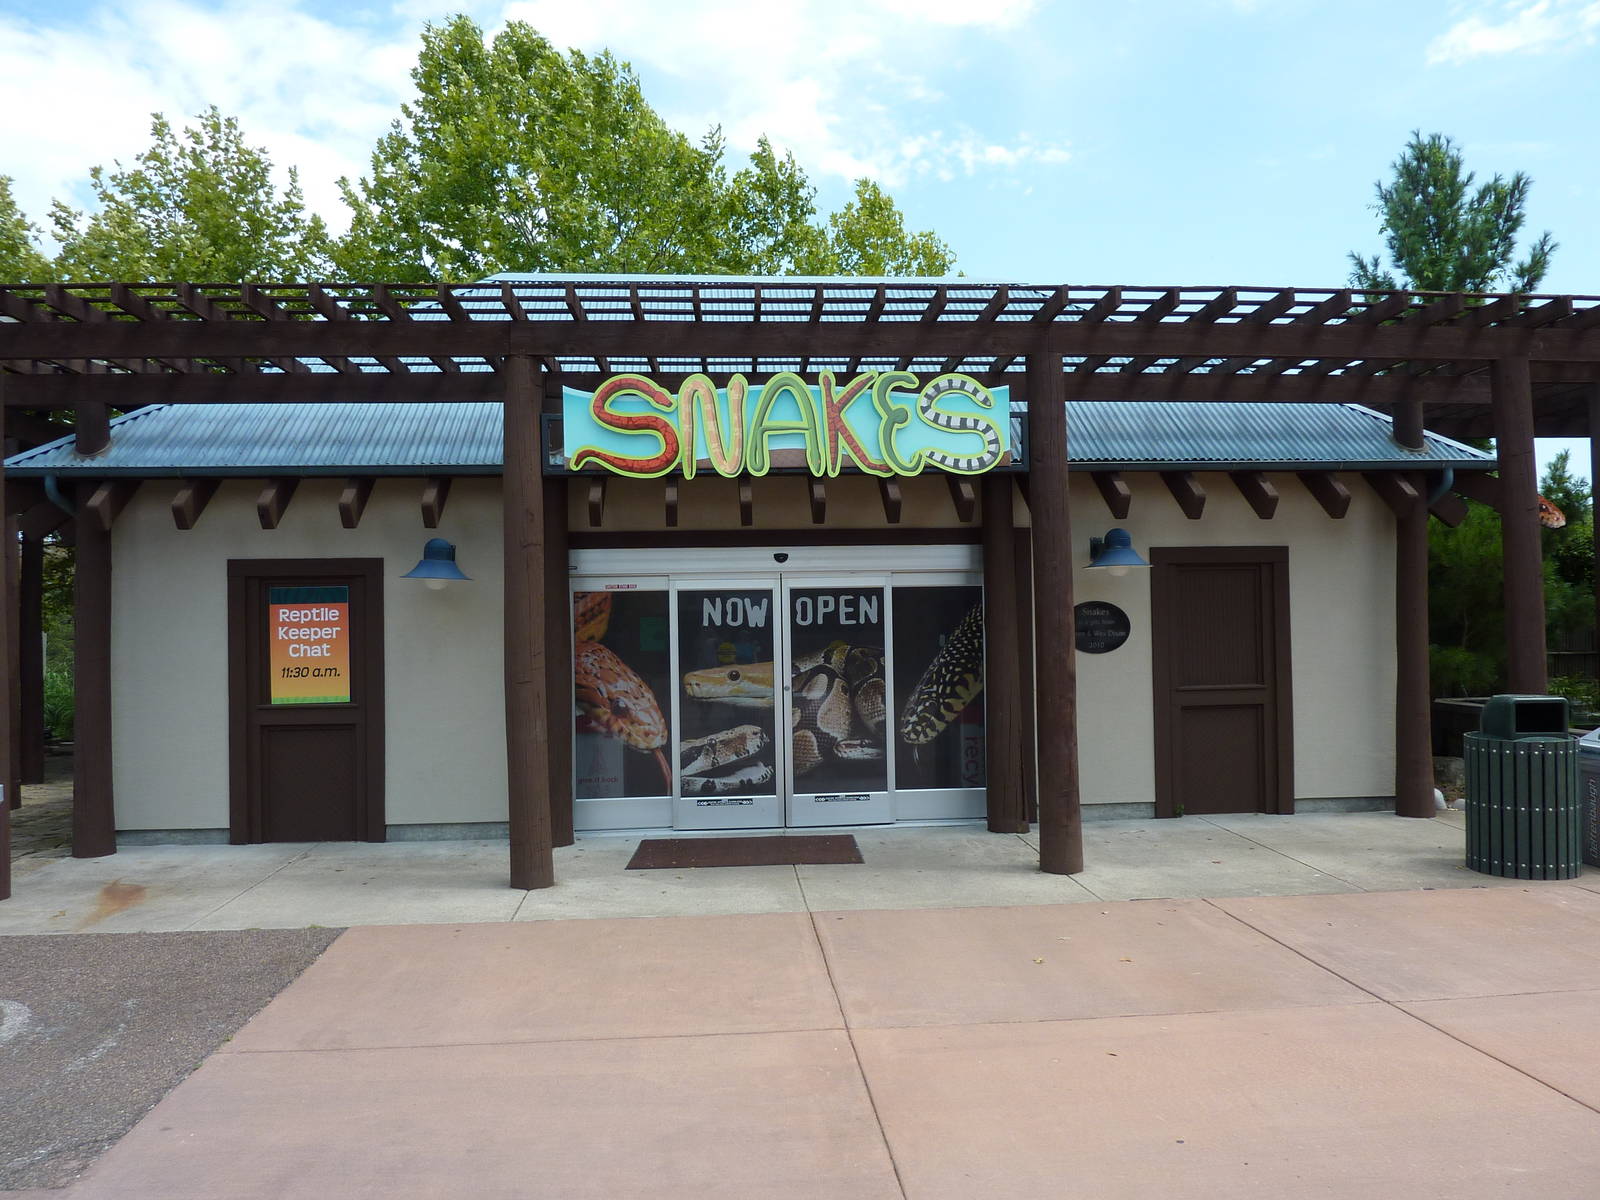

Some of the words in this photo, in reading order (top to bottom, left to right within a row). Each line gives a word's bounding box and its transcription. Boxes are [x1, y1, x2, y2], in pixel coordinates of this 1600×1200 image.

[571, 370, 1004, 478] SNAKES
[279, 607, 340, 624] Reptile
[702, 597, 768, 628] NOW
[795, 595, 878, 626] OPEN
[278, 626, 342, 641] Keeper
[288, 643, 331, 657] Chat
[281, 666, 309, 678] 11:30
[312, 666, 341, 677] a.m.
